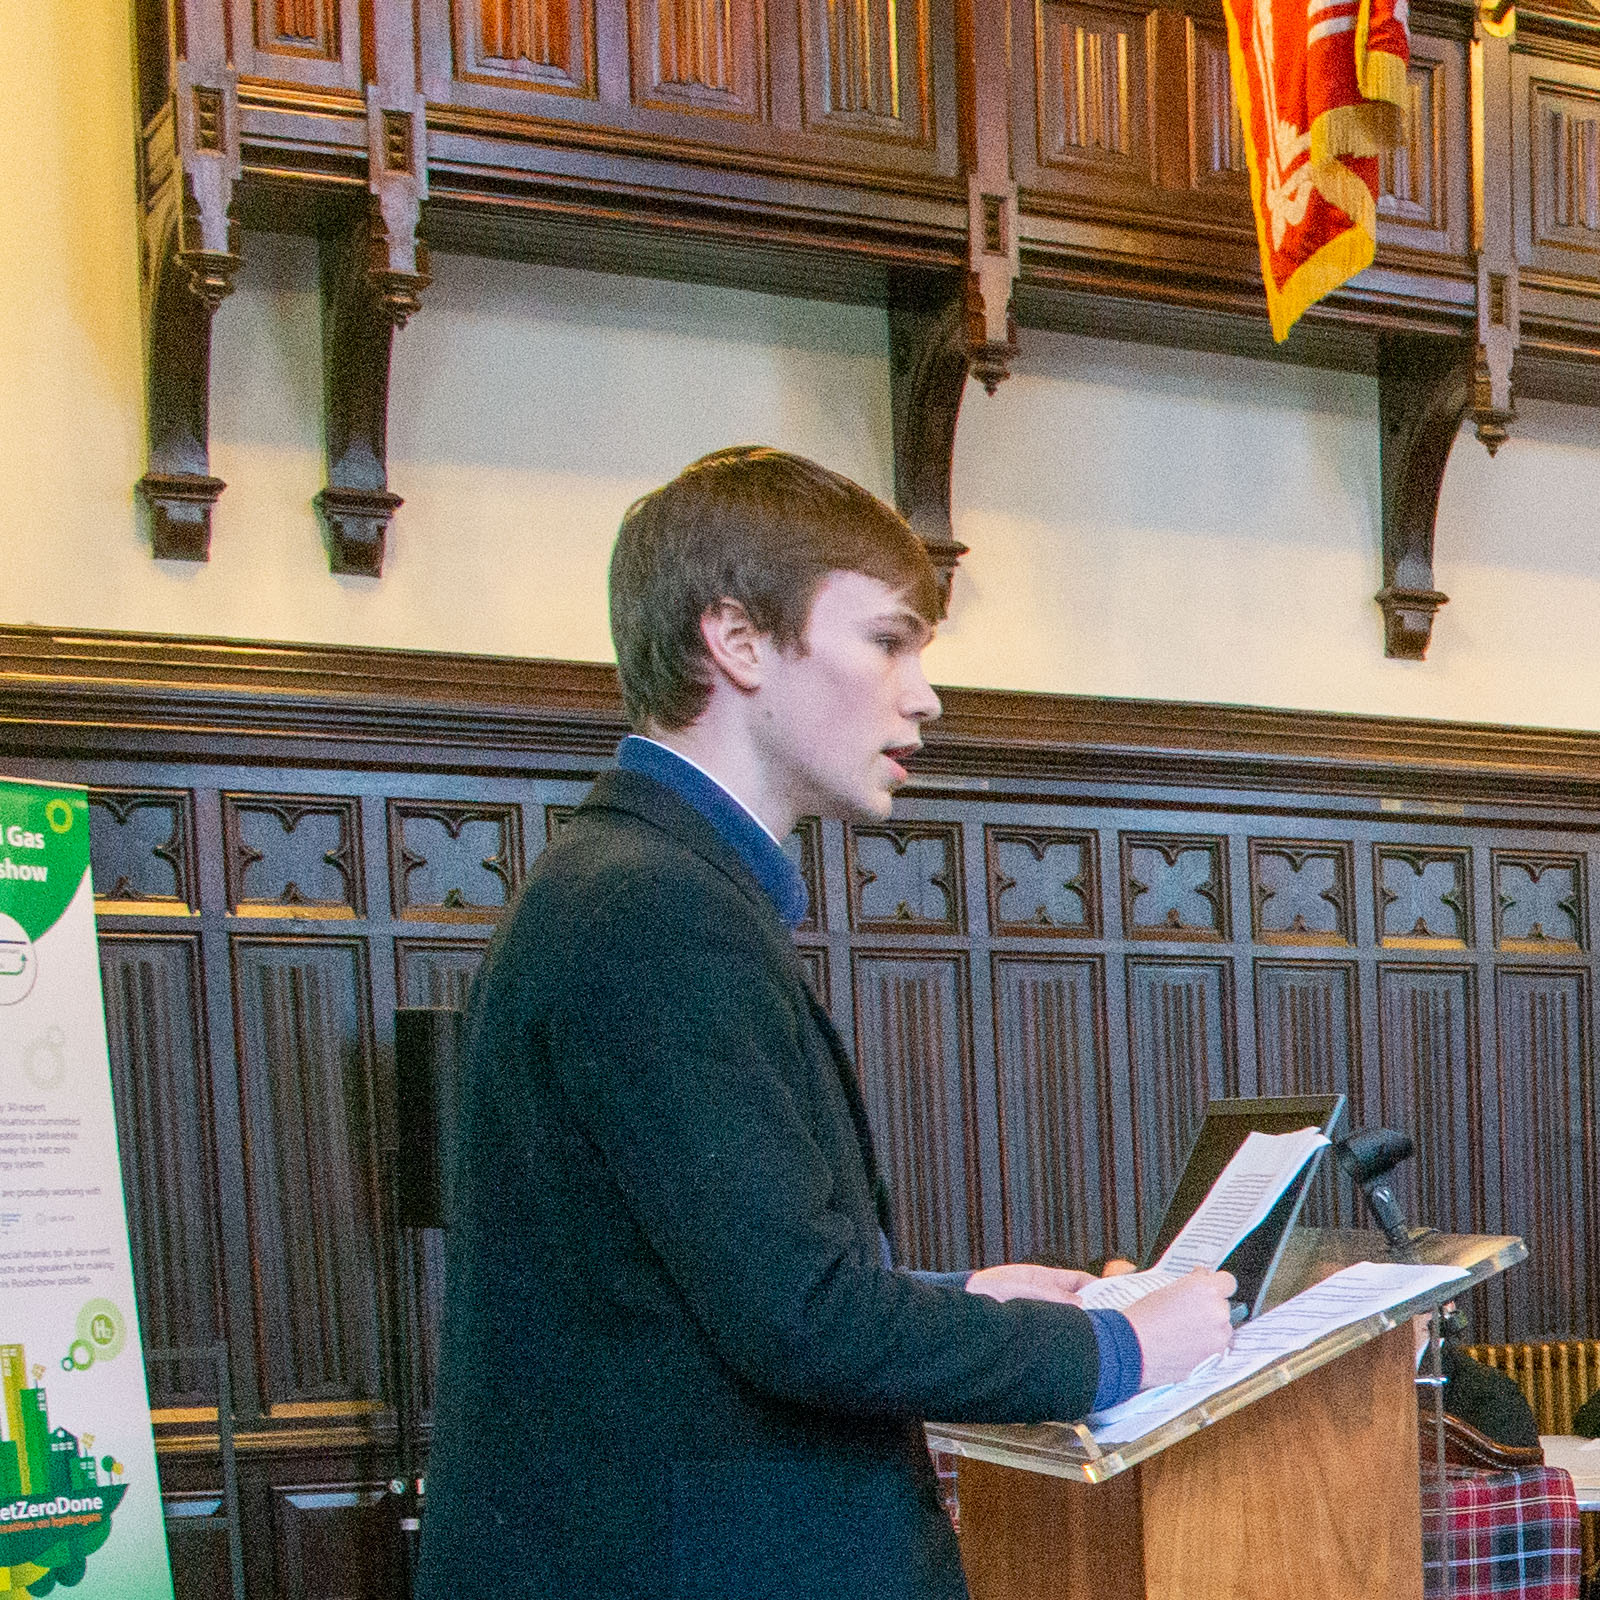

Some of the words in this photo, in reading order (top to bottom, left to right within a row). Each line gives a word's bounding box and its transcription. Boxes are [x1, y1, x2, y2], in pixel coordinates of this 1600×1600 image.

[7, 825, 45, 849] Gas
[0, 857, 48, 883] show
[0, 1496, 103, 1521] etZeroDone
